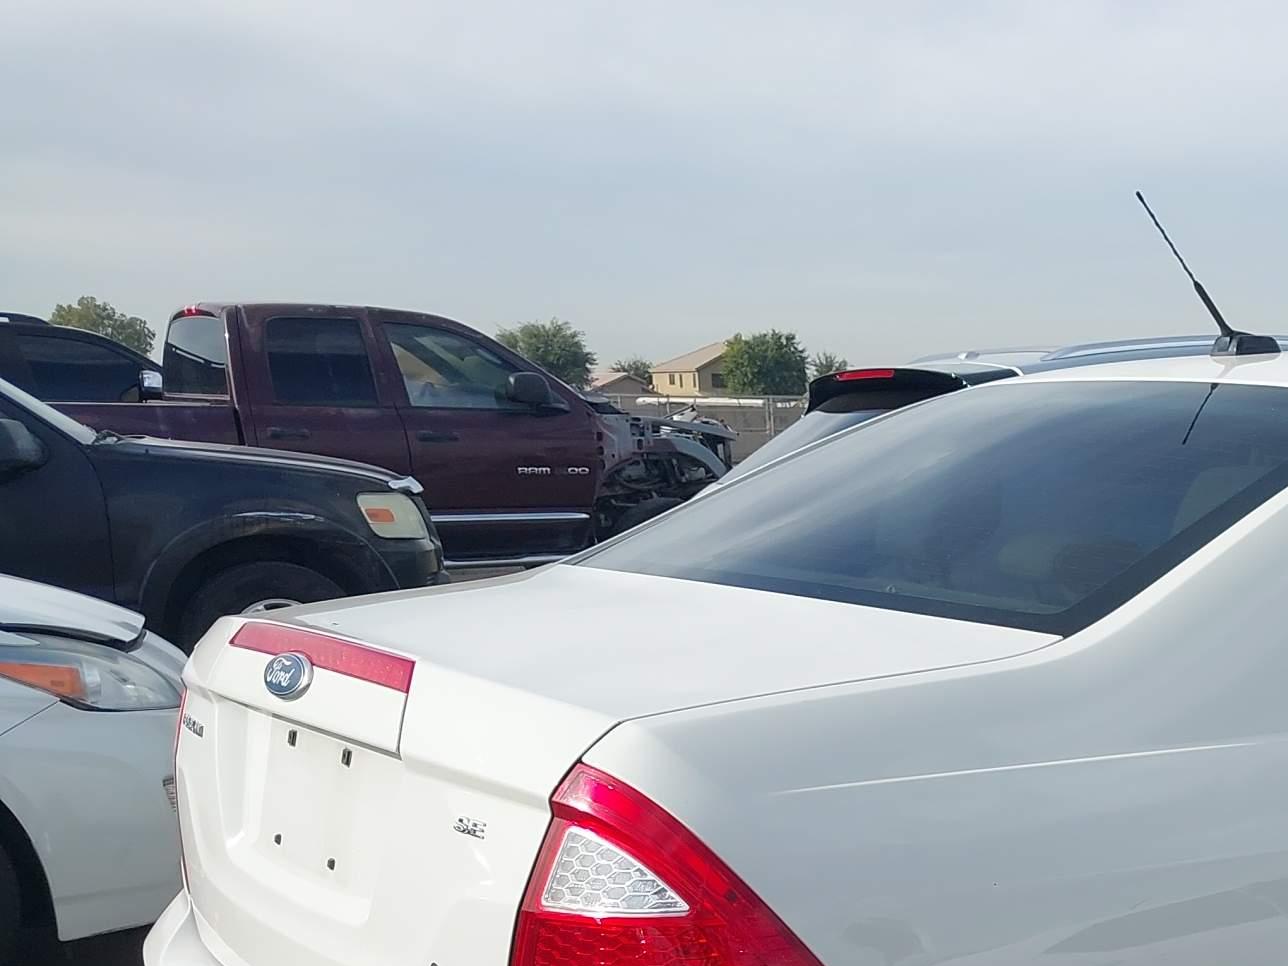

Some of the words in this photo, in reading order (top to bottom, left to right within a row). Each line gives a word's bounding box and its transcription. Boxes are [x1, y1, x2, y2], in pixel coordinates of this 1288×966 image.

[517, 467, 551, 475] RAM
[266, 657, 296, 687] Ford
[453, 816, 487, 840] SE
